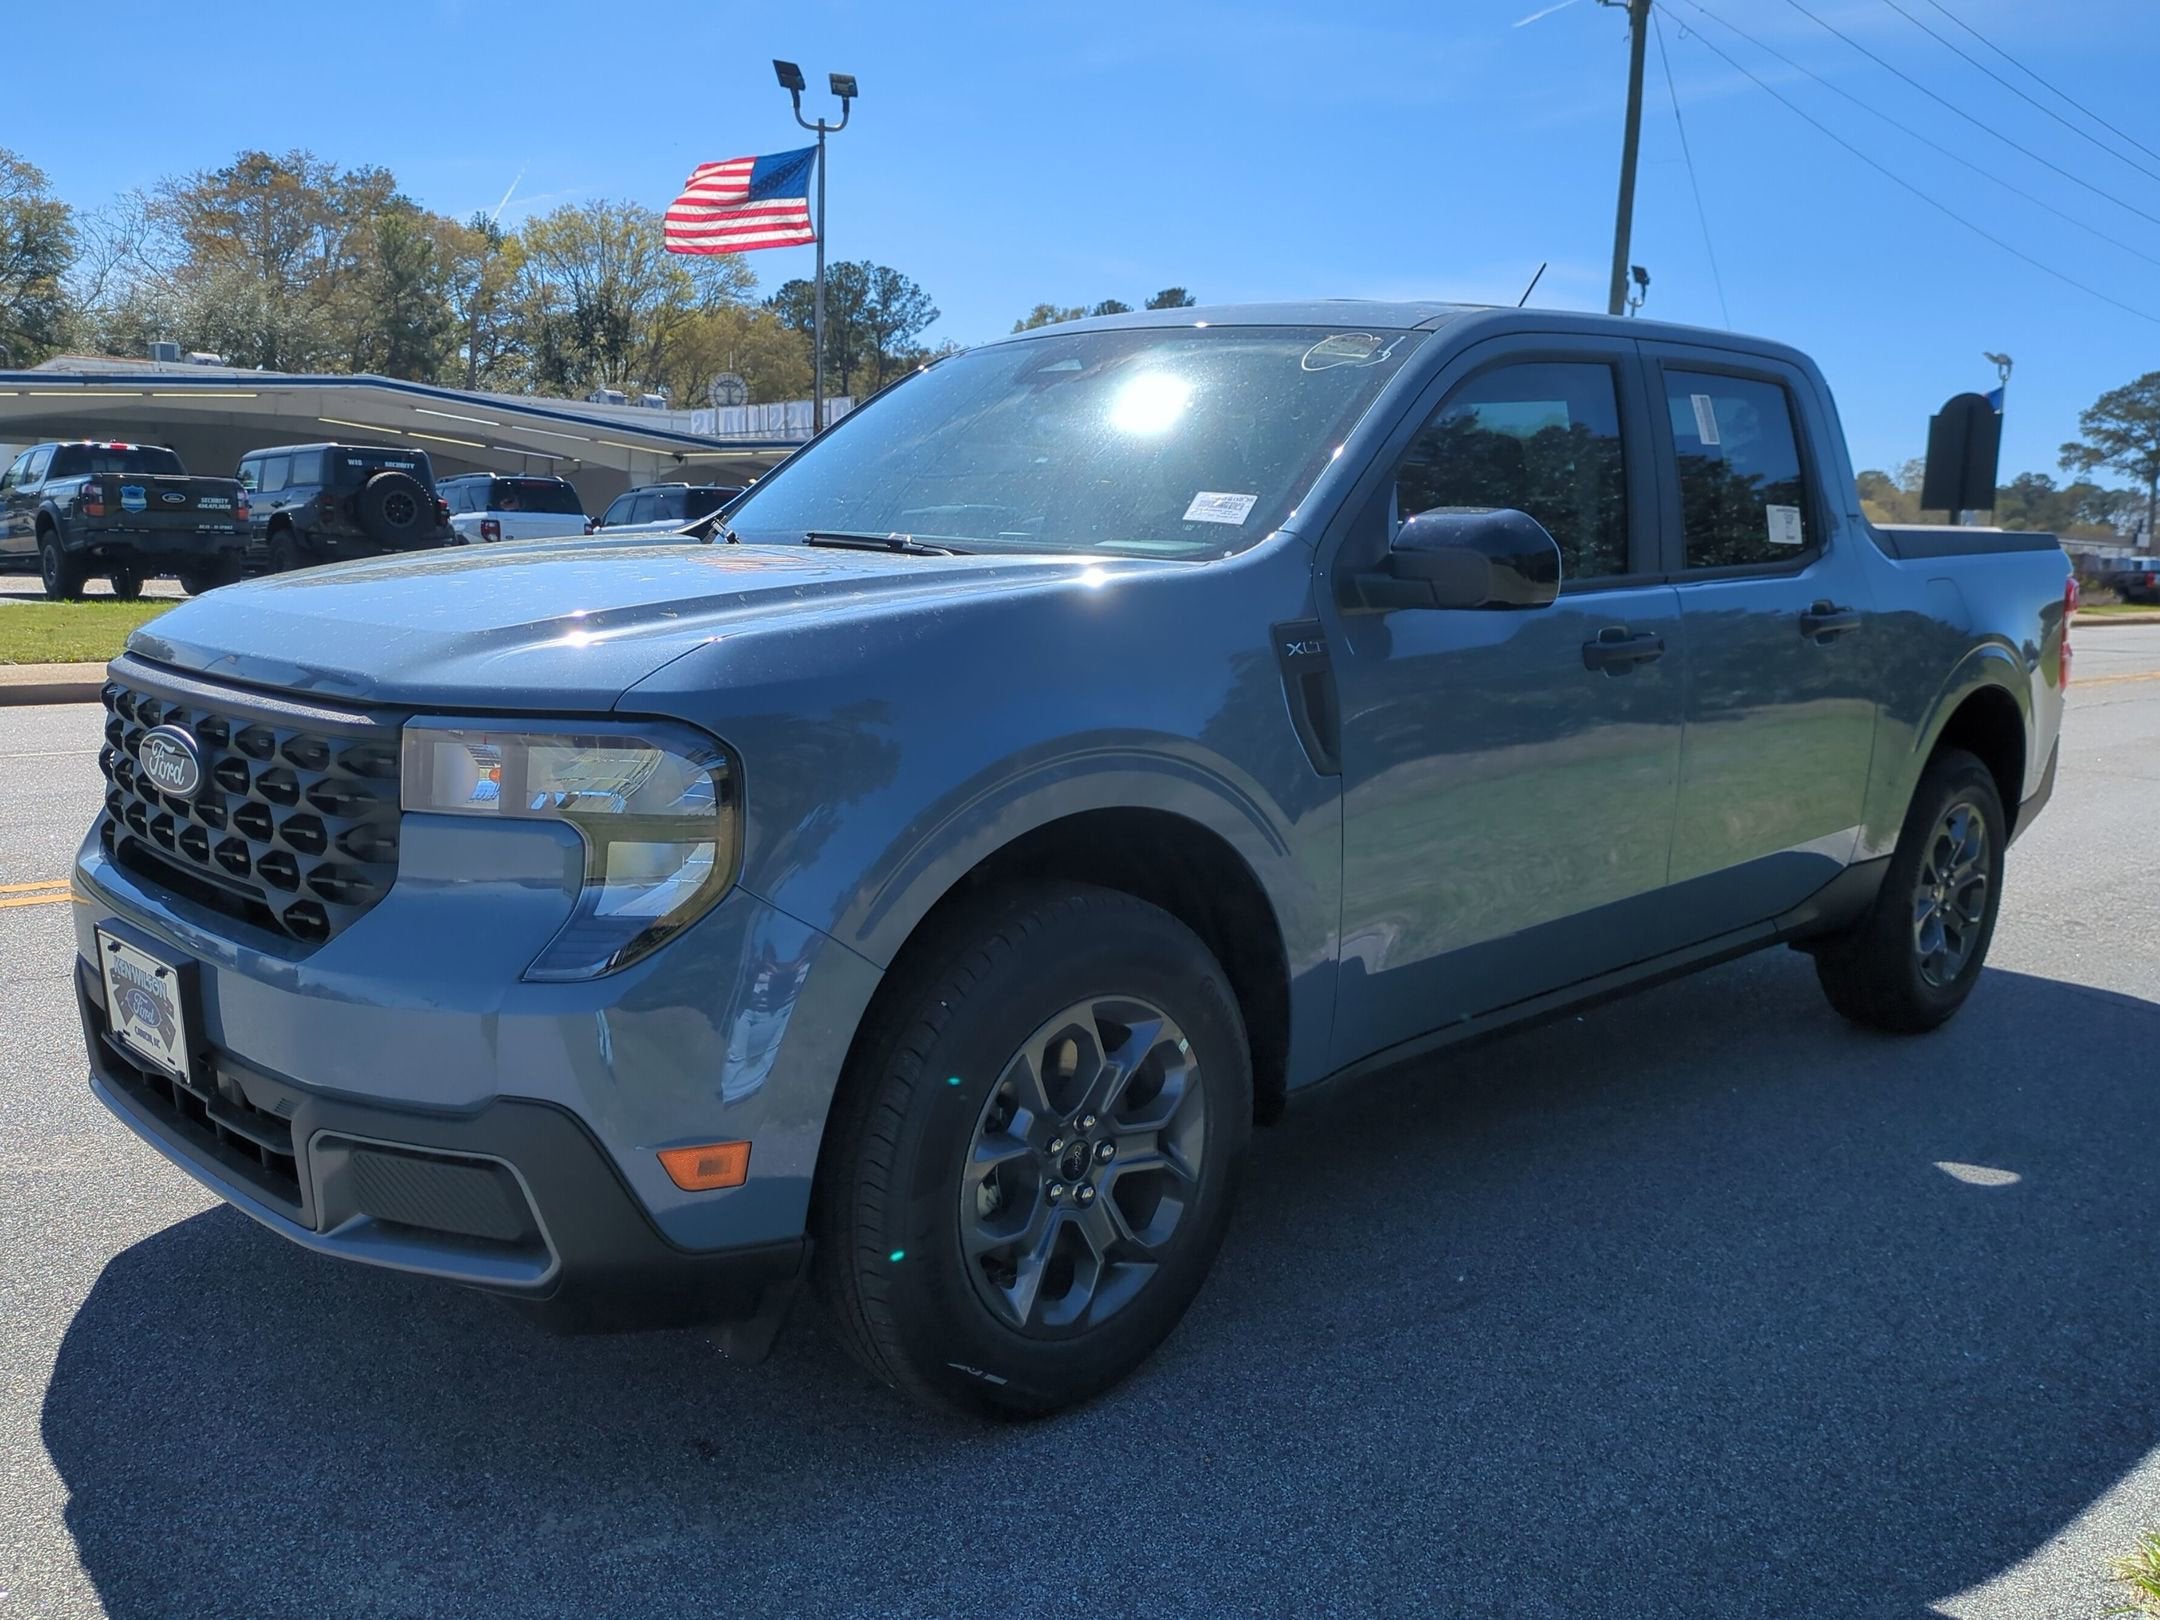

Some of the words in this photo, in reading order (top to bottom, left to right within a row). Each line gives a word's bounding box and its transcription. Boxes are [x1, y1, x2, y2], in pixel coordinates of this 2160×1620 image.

[384, 461, 415, 470] SECURITY
[200, 497, 230, 505] SECURITY
[149, 739, 185, 785] Ford
[113, 955, 132, 981] KEN
[132, 967, 168, 1000] WILSON
[133, 992, 155, 1025] Ford
